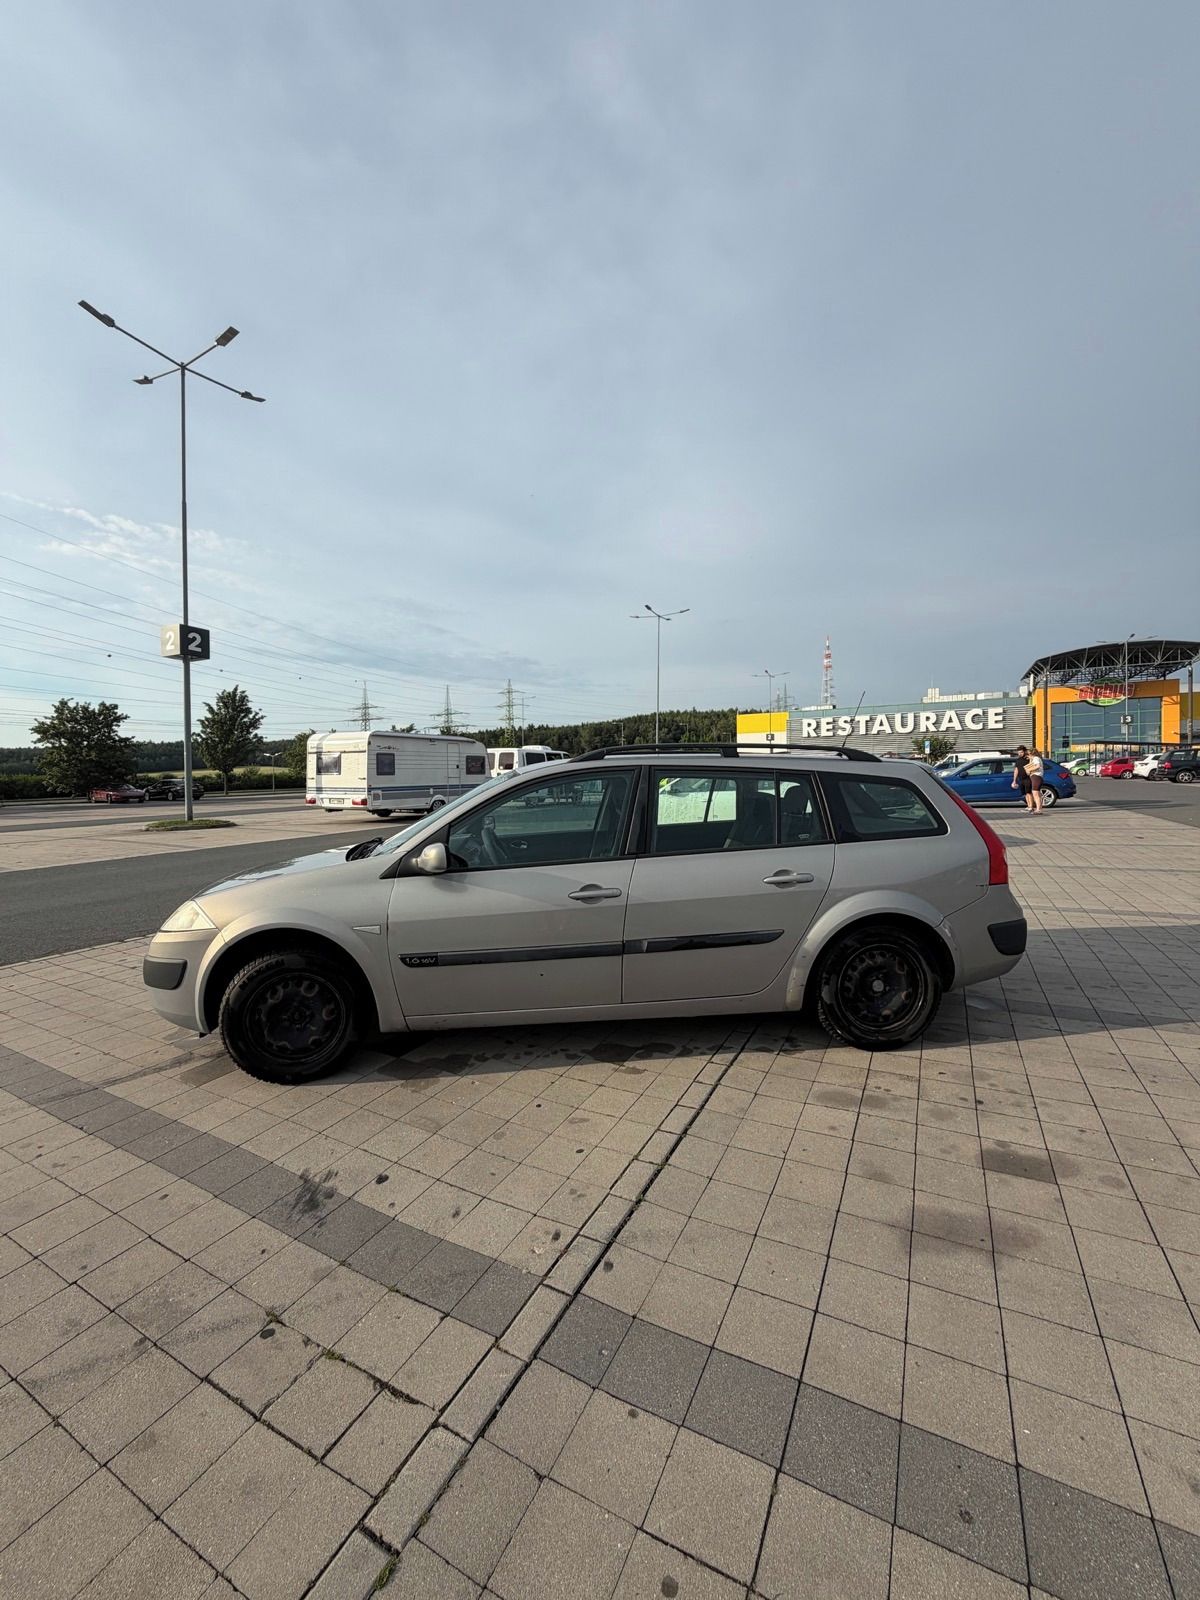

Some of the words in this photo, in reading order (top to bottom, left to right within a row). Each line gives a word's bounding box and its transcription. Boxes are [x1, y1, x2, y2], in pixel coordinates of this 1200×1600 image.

[166, 631, 175, 651] 2
[187, 632, 202, 652] 2
[802, 707, 1005, 738] RESTAURACE
